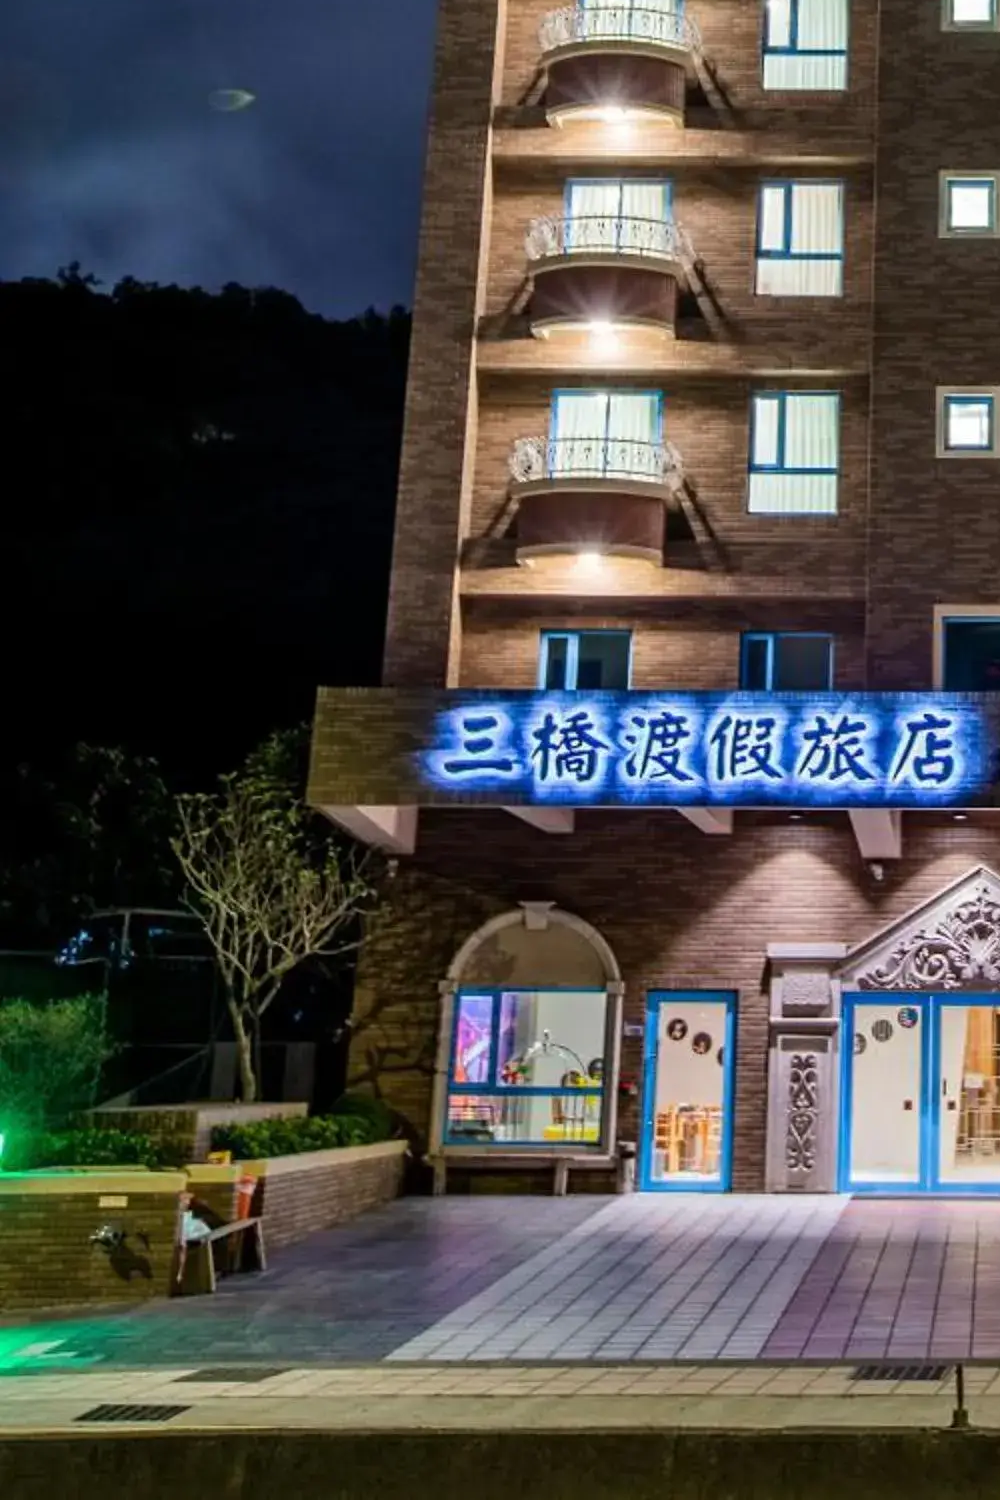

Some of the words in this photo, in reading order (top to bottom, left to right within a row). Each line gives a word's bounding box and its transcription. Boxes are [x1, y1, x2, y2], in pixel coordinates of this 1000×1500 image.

[443, 712, 956, 783] 三橋渡假旅店
